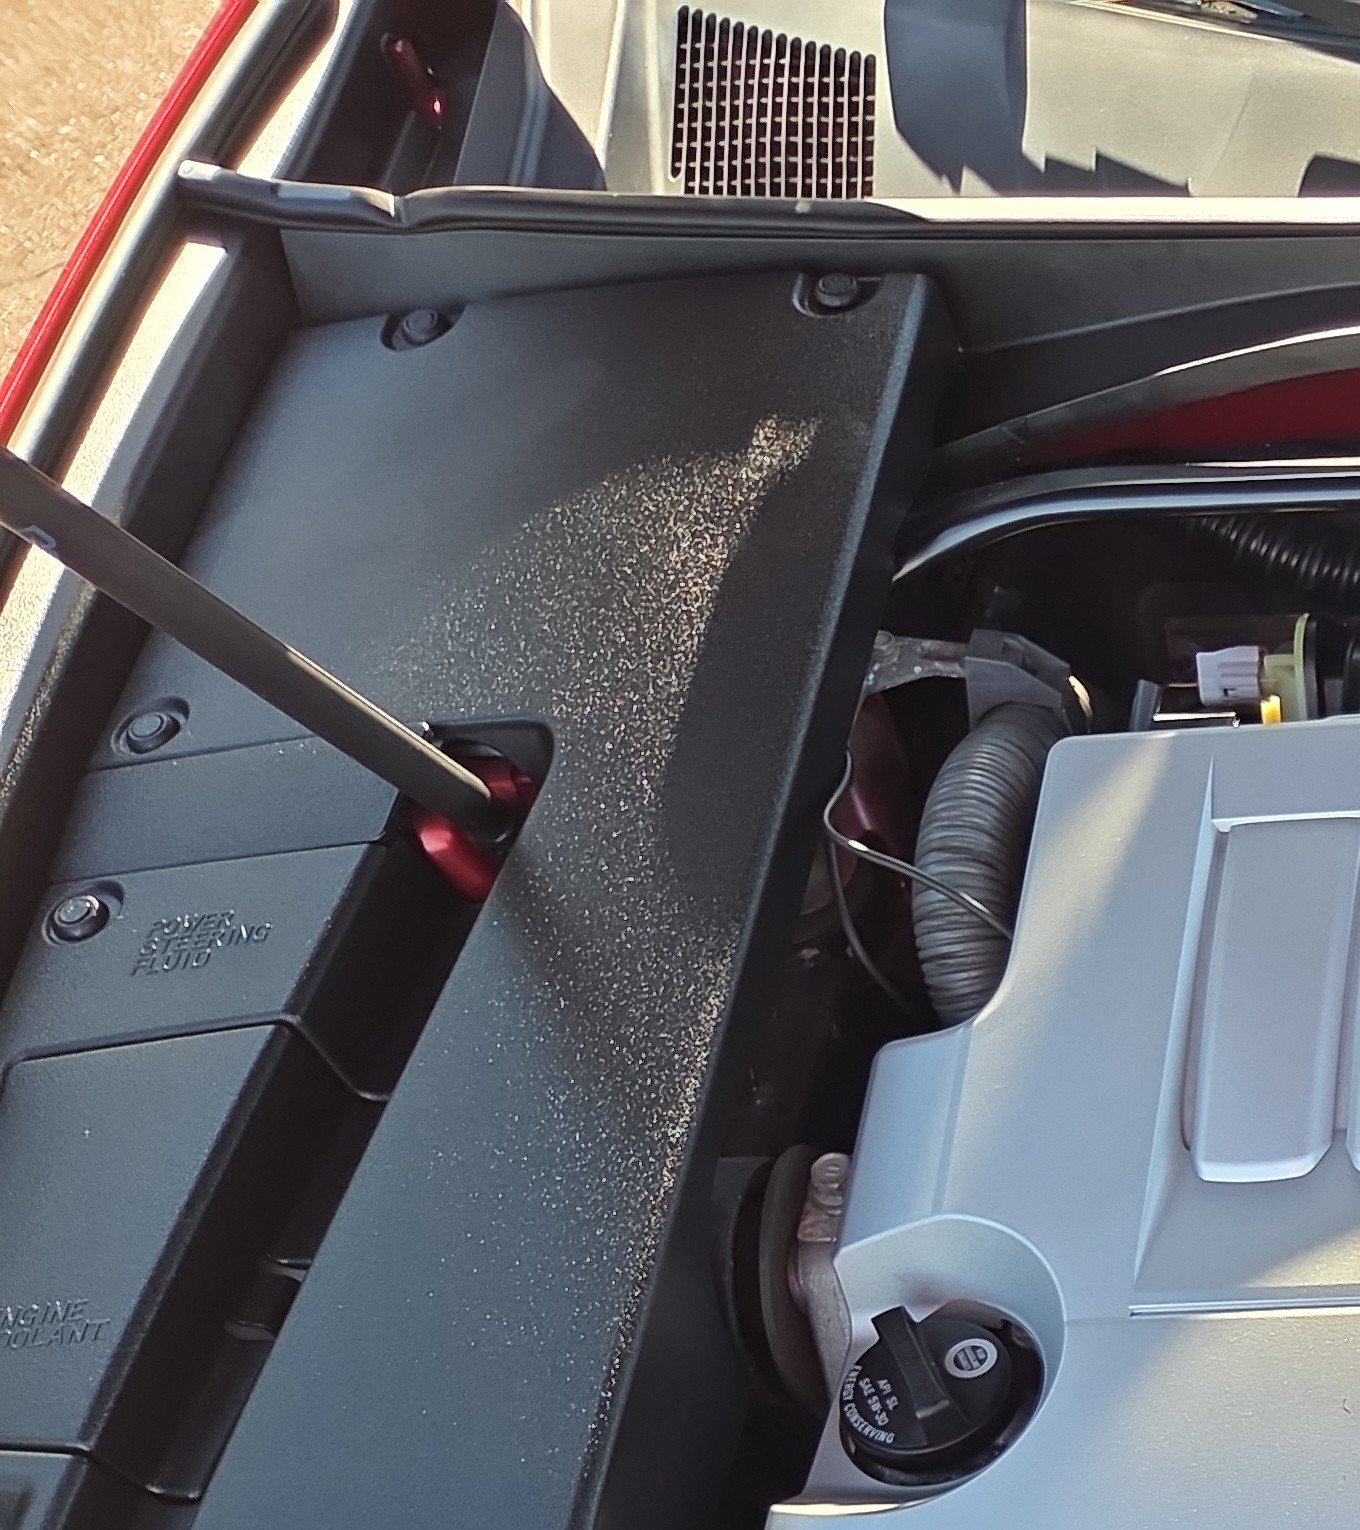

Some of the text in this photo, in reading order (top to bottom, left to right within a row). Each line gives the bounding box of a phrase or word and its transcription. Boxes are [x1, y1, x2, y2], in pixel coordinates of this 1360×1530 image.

[139, 922, 271, 956] STEERING
[145, 909, 235, 939] POWER
[130, 950, 211, 977] FLUID
[0, 1298, 88, 1329] NGINE
